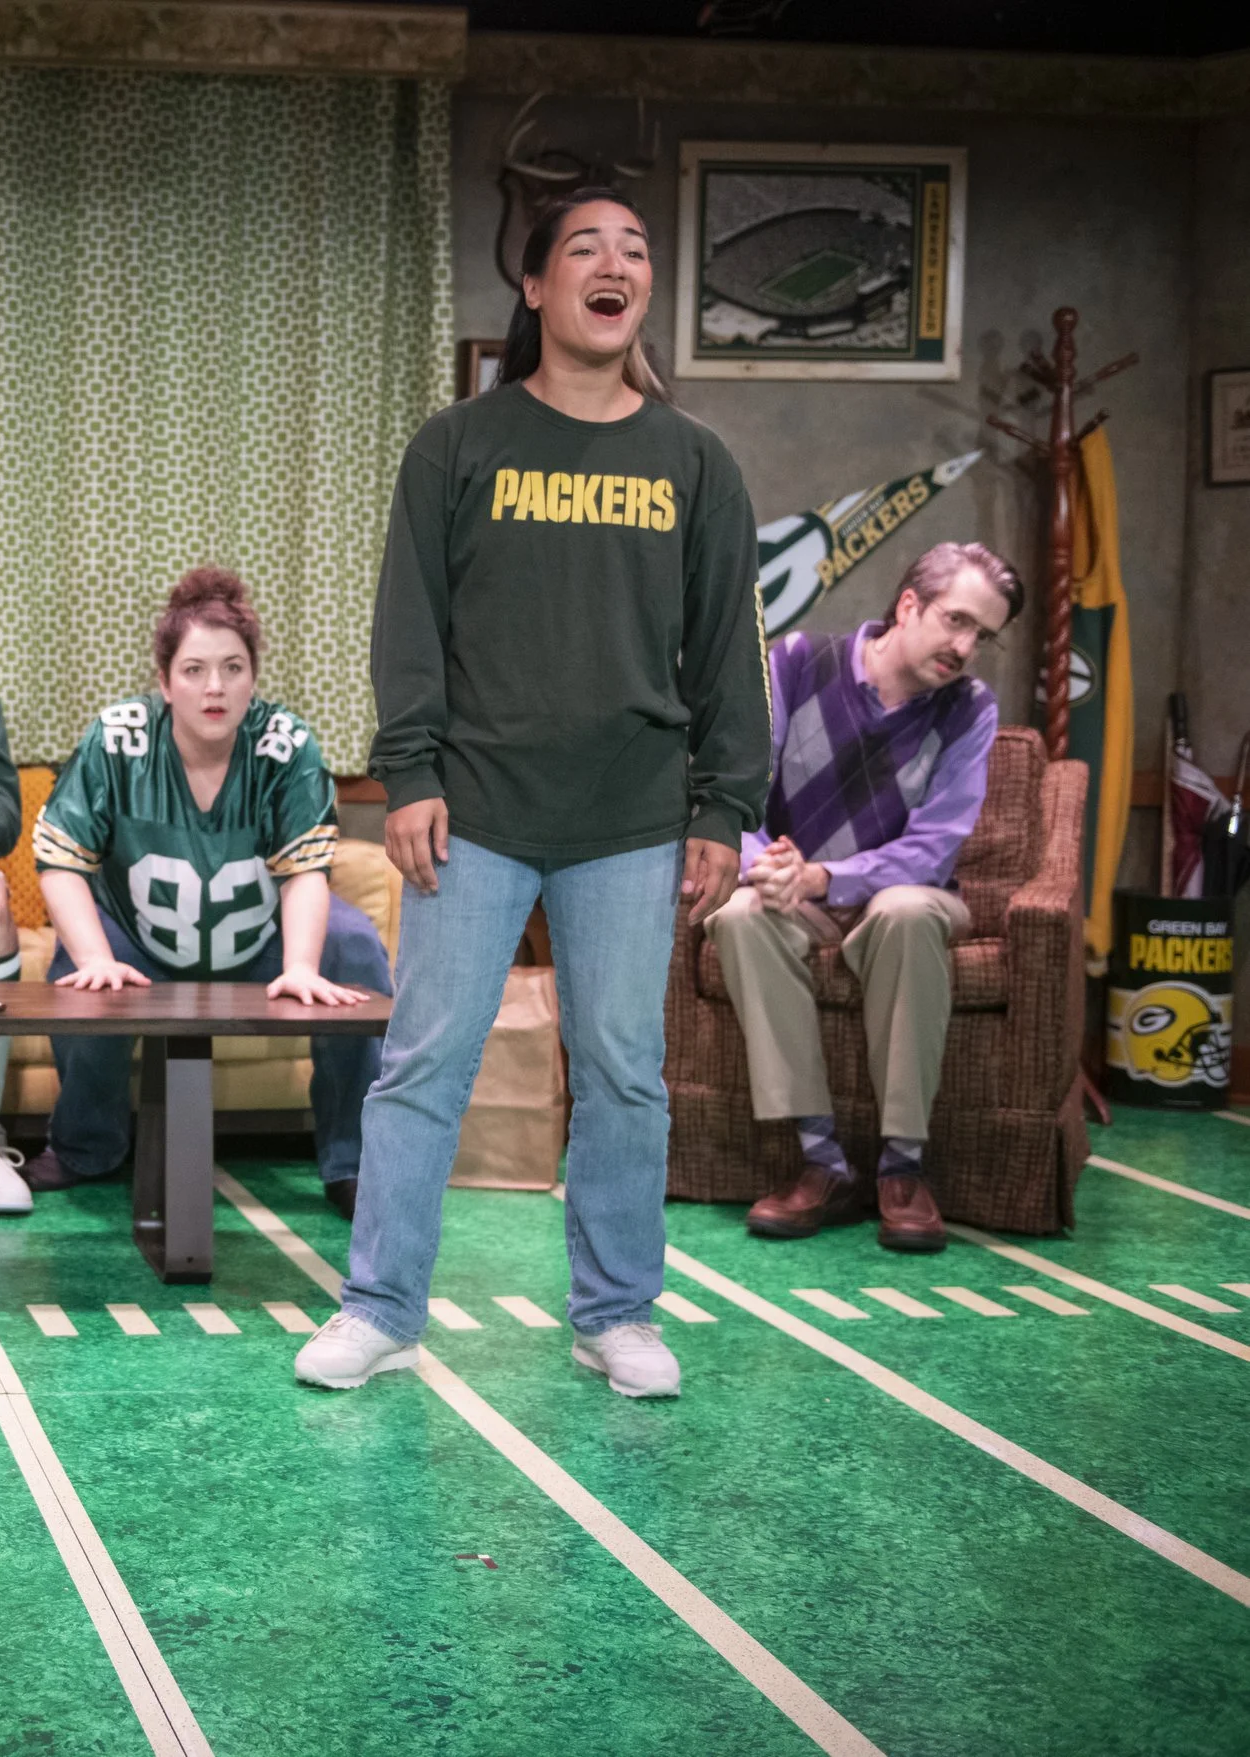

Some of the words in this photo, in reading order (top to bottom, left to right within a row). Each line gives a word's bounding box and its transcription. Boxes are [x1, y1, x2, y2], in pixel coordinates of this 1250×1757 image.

[491, 468, 676, 532] PACKERS
[816, 475, 929, 588] PACKERS
[101, 702, 148, 757] 82
[256, 712, 308, 763] 82
[129, 853, 278, 971] 82
[1146, 919, 1202, 936] GREEN
[1205, 921, 1227, 936] BAY
